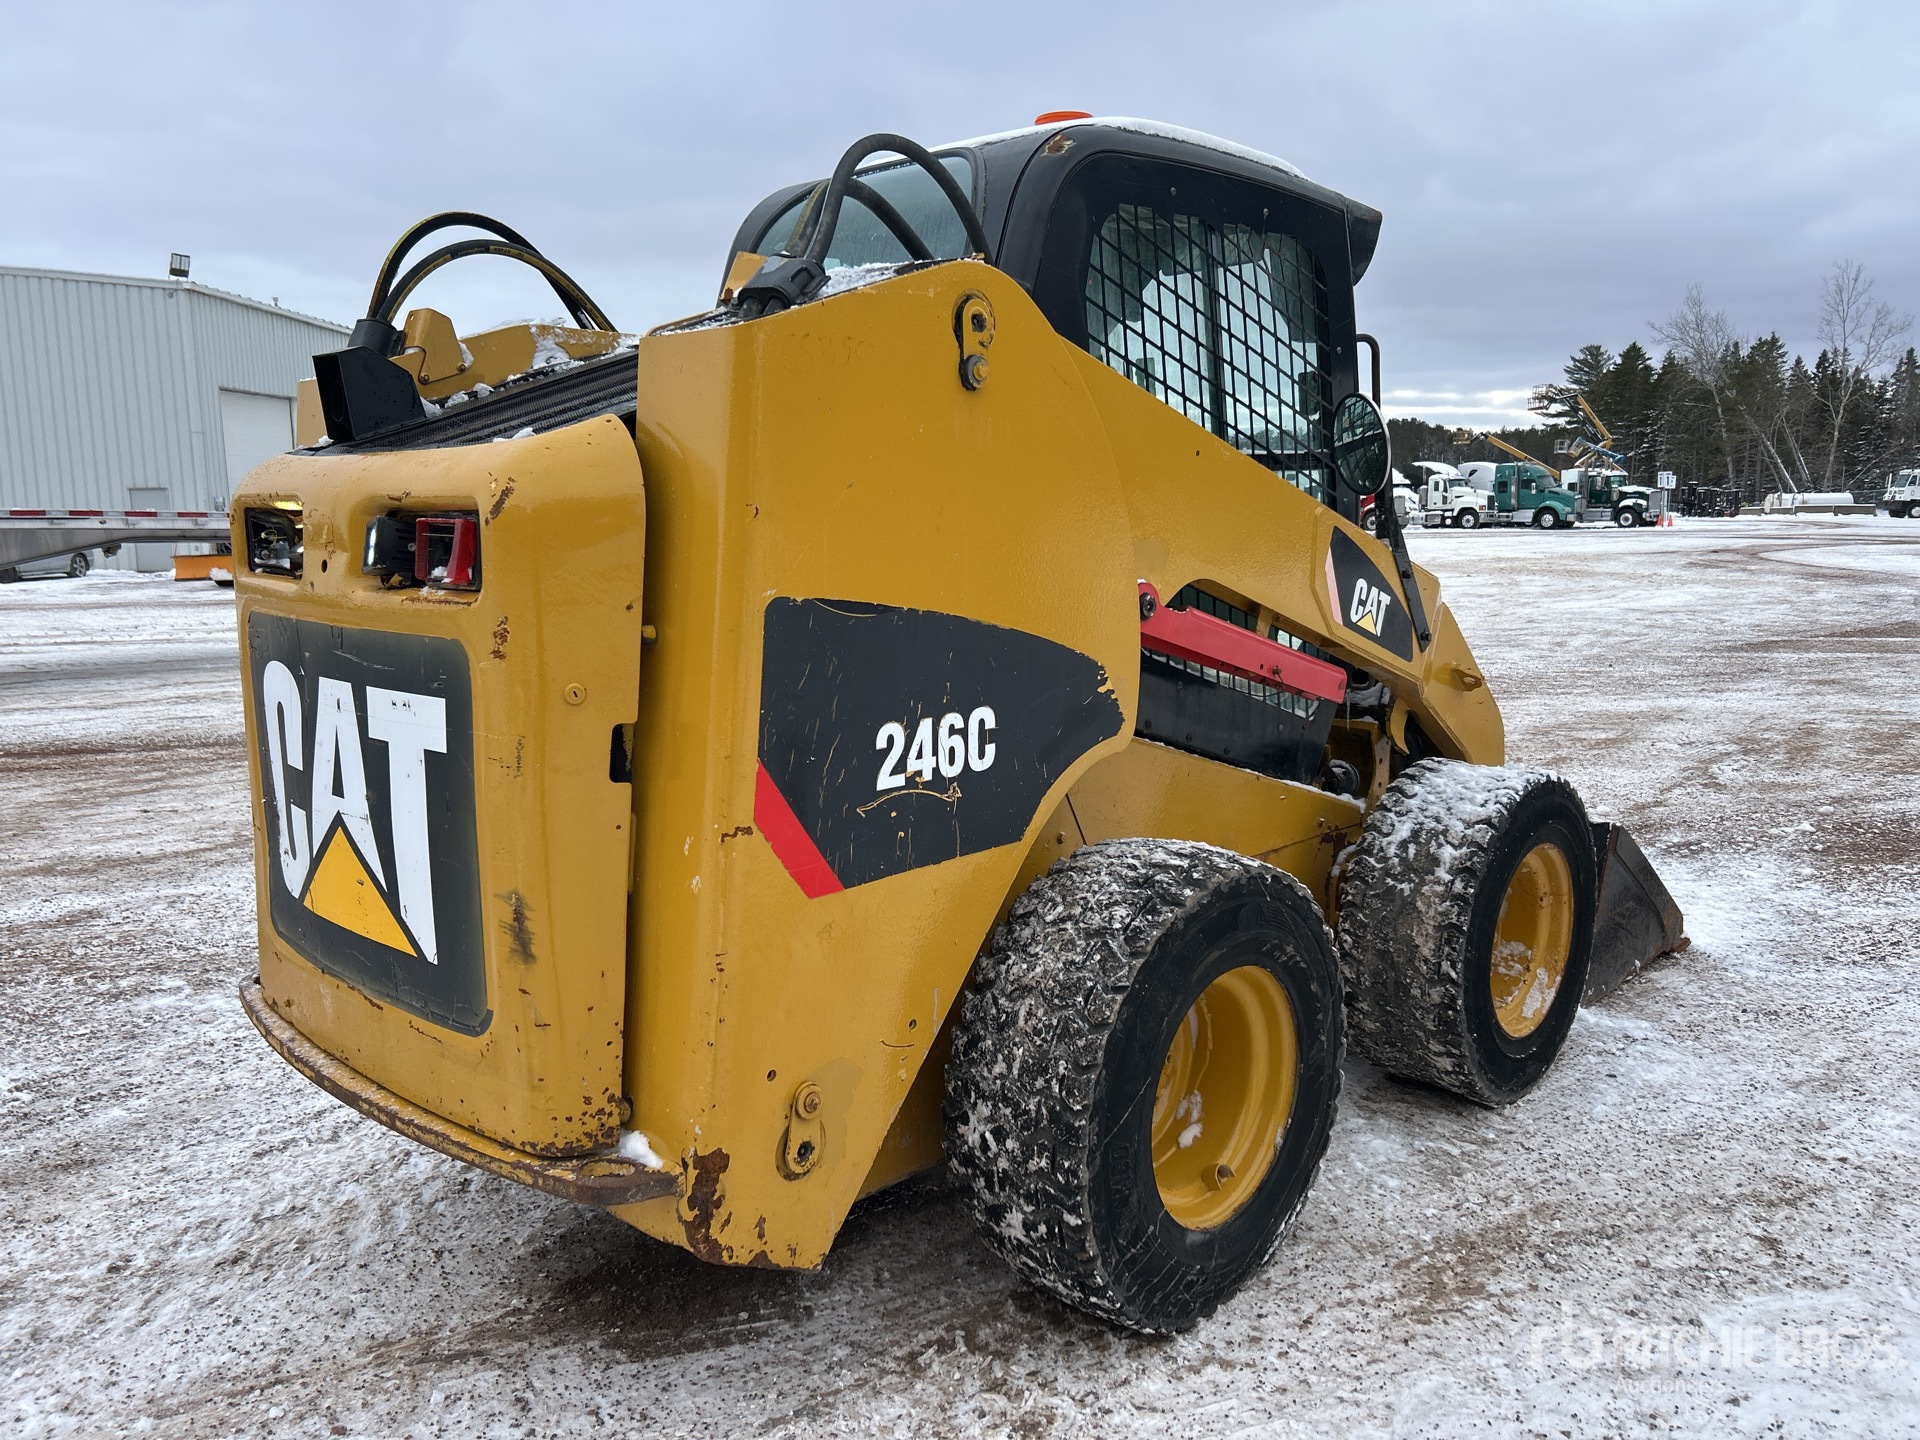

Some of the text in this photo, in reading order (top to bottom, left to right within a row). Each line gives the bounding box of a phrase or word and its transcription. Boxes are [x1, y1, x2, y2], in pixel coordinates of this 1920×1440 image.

[1350, 578, 1391, 637] CAT
[875, 706, 997, 791] 246C
[263, 660, 447, 966] CAT
